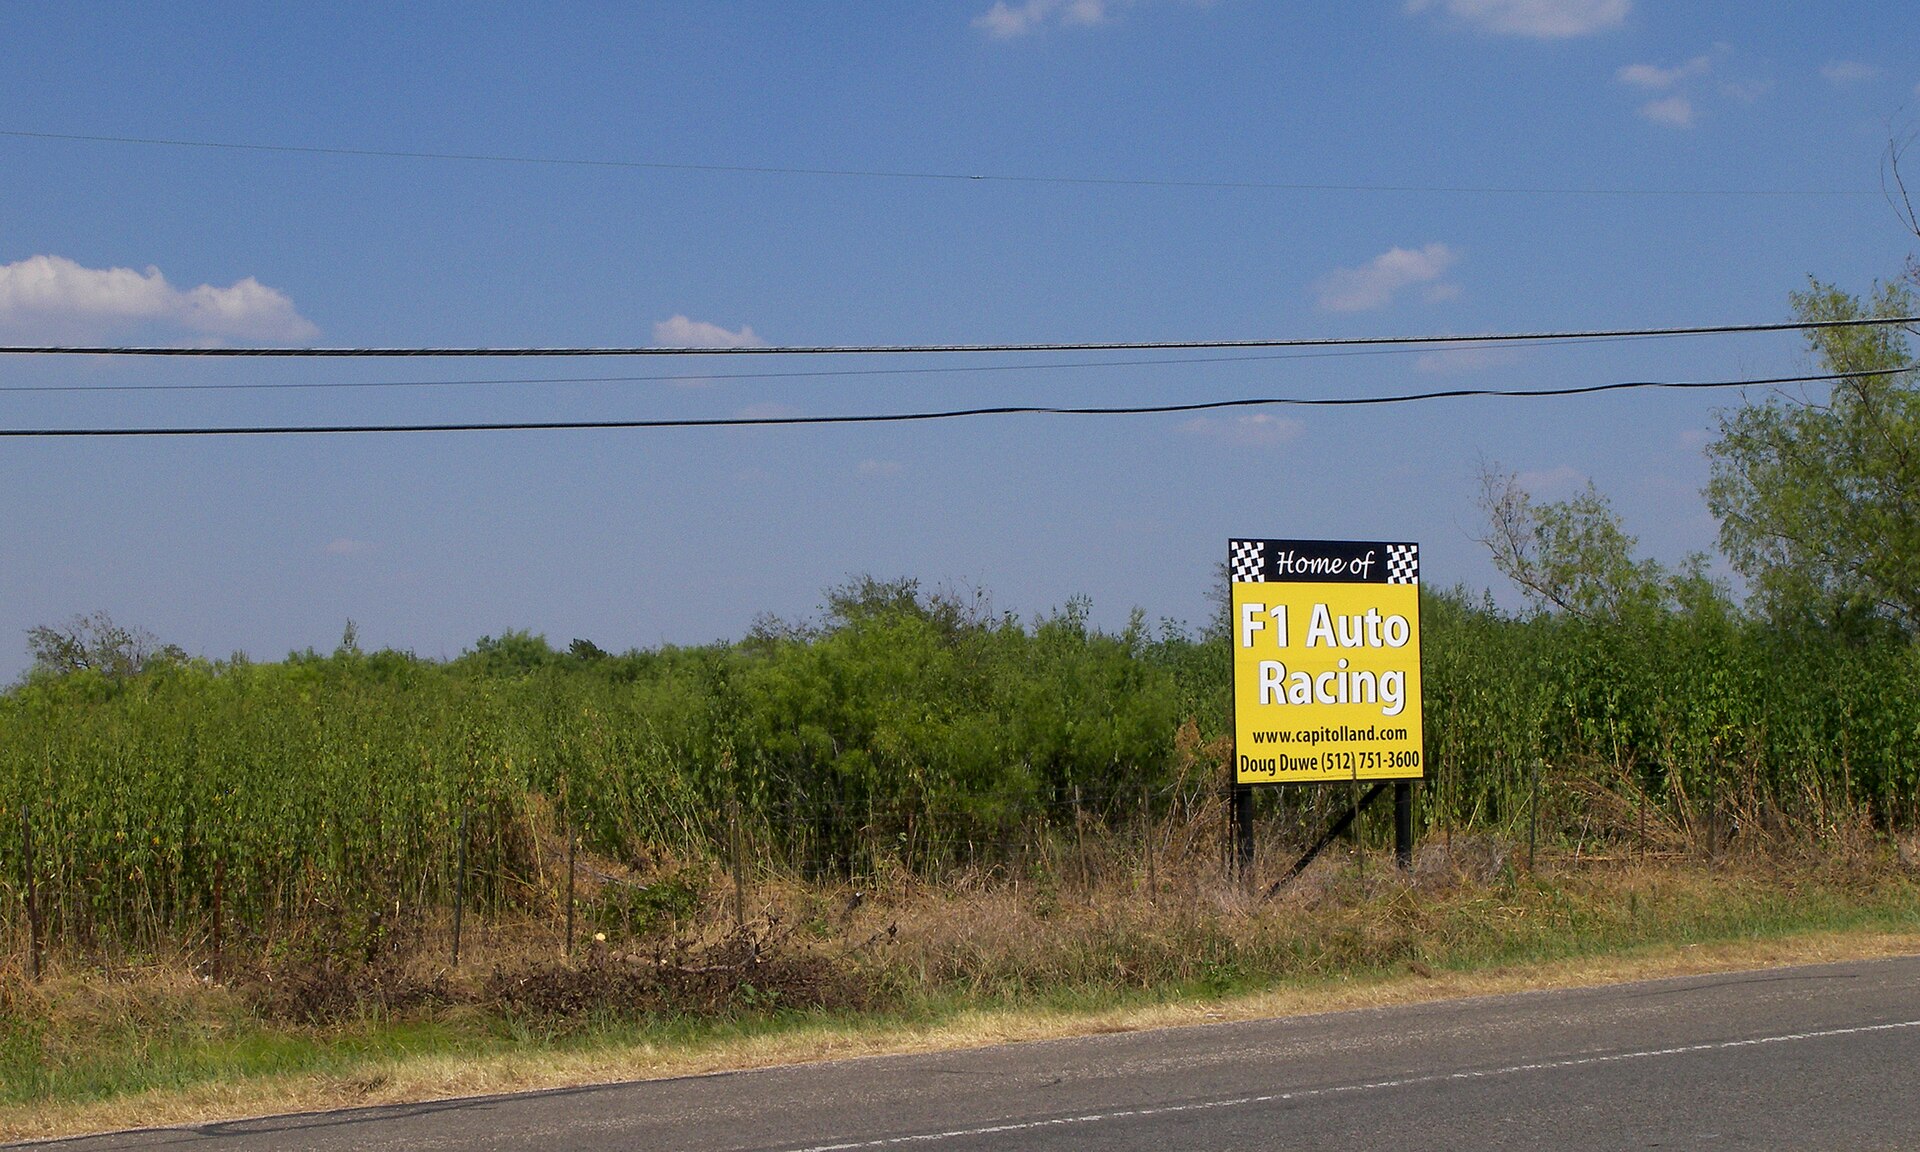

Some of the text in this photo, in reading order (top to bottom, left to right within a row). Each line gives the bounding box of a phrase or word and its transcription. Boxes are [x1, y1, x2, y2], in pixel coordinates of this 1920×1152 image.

[1277, 550, 1375, 579] Home of
[1241, 602, 1410, 648] F1 Auto
[1258, 658, 1406, 716] Racing
[1253, 725, 1408, 746] www.capitolland.com
[1240, 754, 1276, 776] Doug
[1279, 753, 1318, 771] Duwe
[1359, 750, 1419, 769] 751-3600
